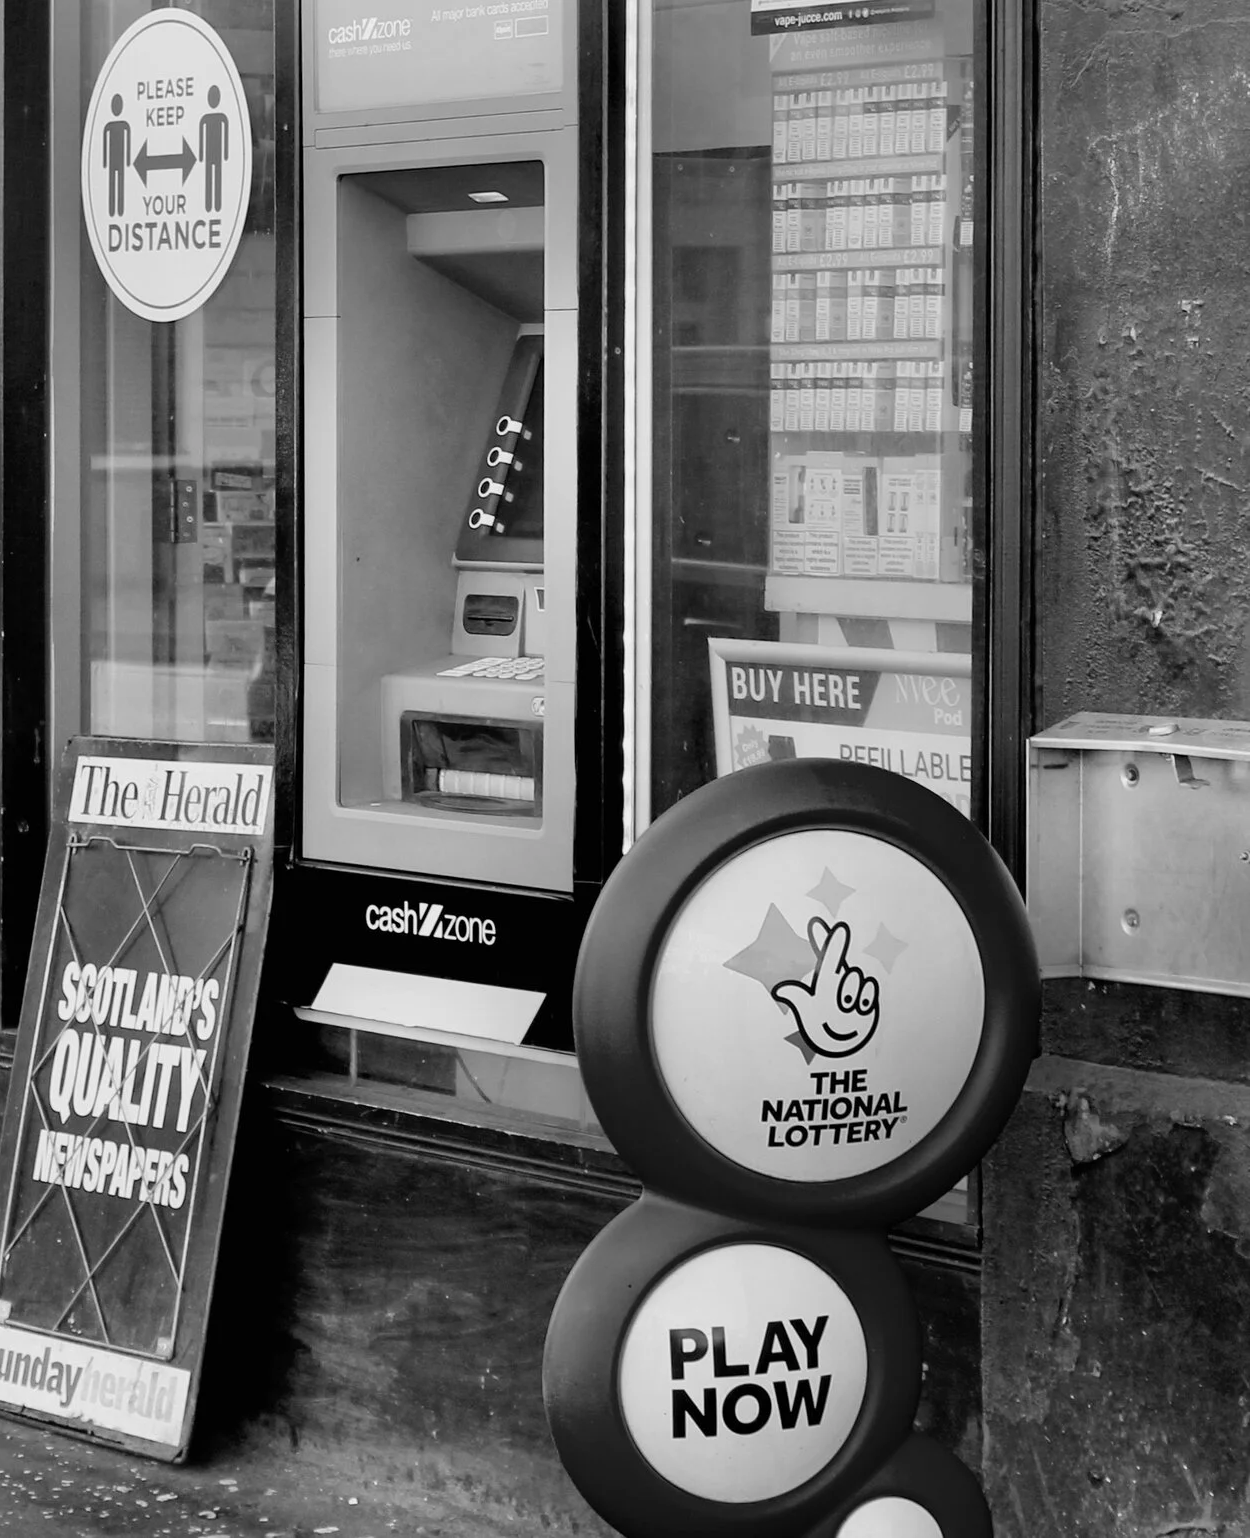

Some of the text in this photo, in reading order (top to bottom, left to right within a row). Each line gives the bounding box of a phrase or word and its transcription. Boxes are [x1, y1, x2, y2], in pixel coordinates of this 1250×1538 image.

[442, 8, 464, 24] major
[465, 4, 485, 19] bank
[486, 1, 510, 16] cards
[773, 10, 843, 28] vape-jucce.com
[793, 32, 817, 46] Vape
[818, 25, 870, 44] salt-based
[368, 44, 383, 56] you
[383, 41, 401, 54] need
[790, 51, 802, 62] an
[804, 47, 828, 61] even
[829, 42, 876, 58] smoother
[904, 63, 934, 79] £2.99
[137, 77, 194, 101] PLEASE
[146, 106, 184, 127] KEEP
[143, 194, 186, 216] YOUR
[109, 219, 222, 252] DISTANCE
[820, 253, 849, 268] £2.99
[903, 248, 934, 264] £2.99
[731, 666, 862, 711] BUY HERE
[934, 708, 963, 726] Pod
[80, 764, 264, 827] The Herald
[57, 960, 220, 1041] SCOTLAND'S
[48, 1028, 208, 1133] QUALITY
[810, 1068, 868, 1095] THE
[760, 1091, 908, 1123] NATIONAL
[32, 1128, 191, 1210] NEWSPAPERS
[668, 1315, 830, 1381] PLAY
[671, 1374, 832, 1439] NOW
